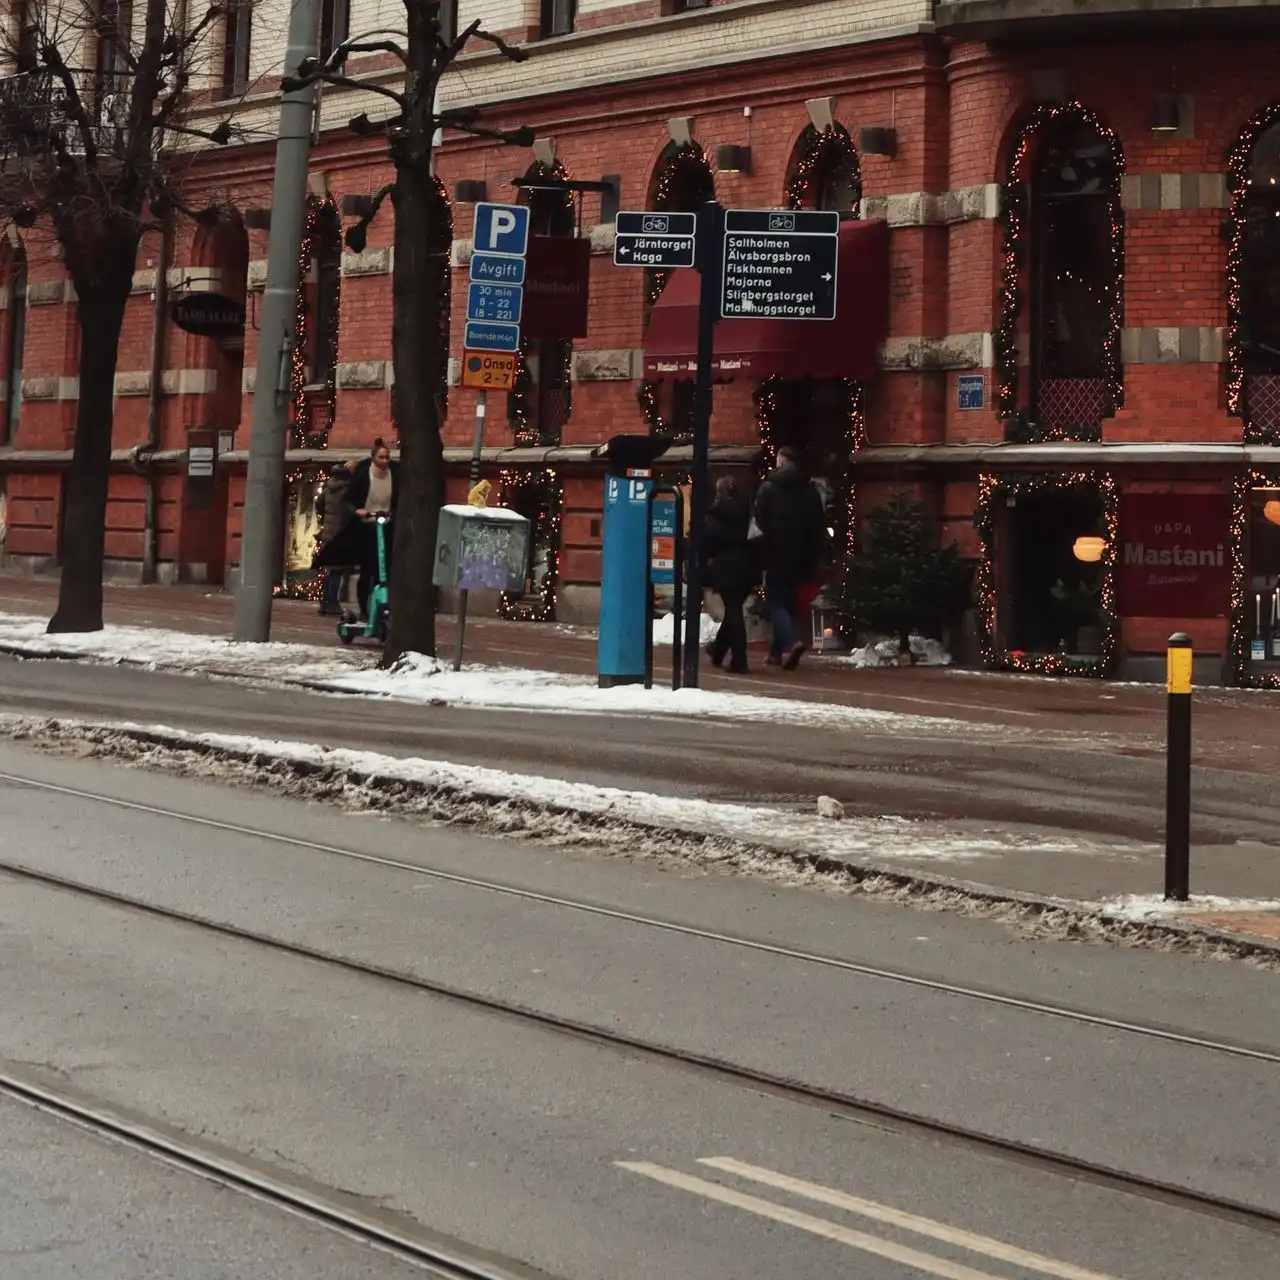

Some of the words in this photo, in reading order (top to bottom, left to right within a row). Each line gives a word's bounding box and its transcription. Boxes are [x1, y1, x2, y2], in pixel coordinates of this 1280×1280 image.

[634, 239, 692, 252] Järntorget
[728, 237, 790, 248] Saltholmen
[633, 252, 663, 264] Haga
[728, 248, 811, 263] Älvsborgsbron
[479, 262, 517, 277] Avgift
[727, 263, 793, 274] Fiskhamnen
[726, 277, 772, 289] Majorna
[479, 286, 491, 296] 30
[494, 287, 512, 297] min
[726, 290, 814, 303] Stigbergstorget
[499, 299, 510, 308] 22
[483, 358, 513, 370] Onsd
[1154, 522, 1192, 535] PAPA
[1124, 542, 1224, 566] Mastani
